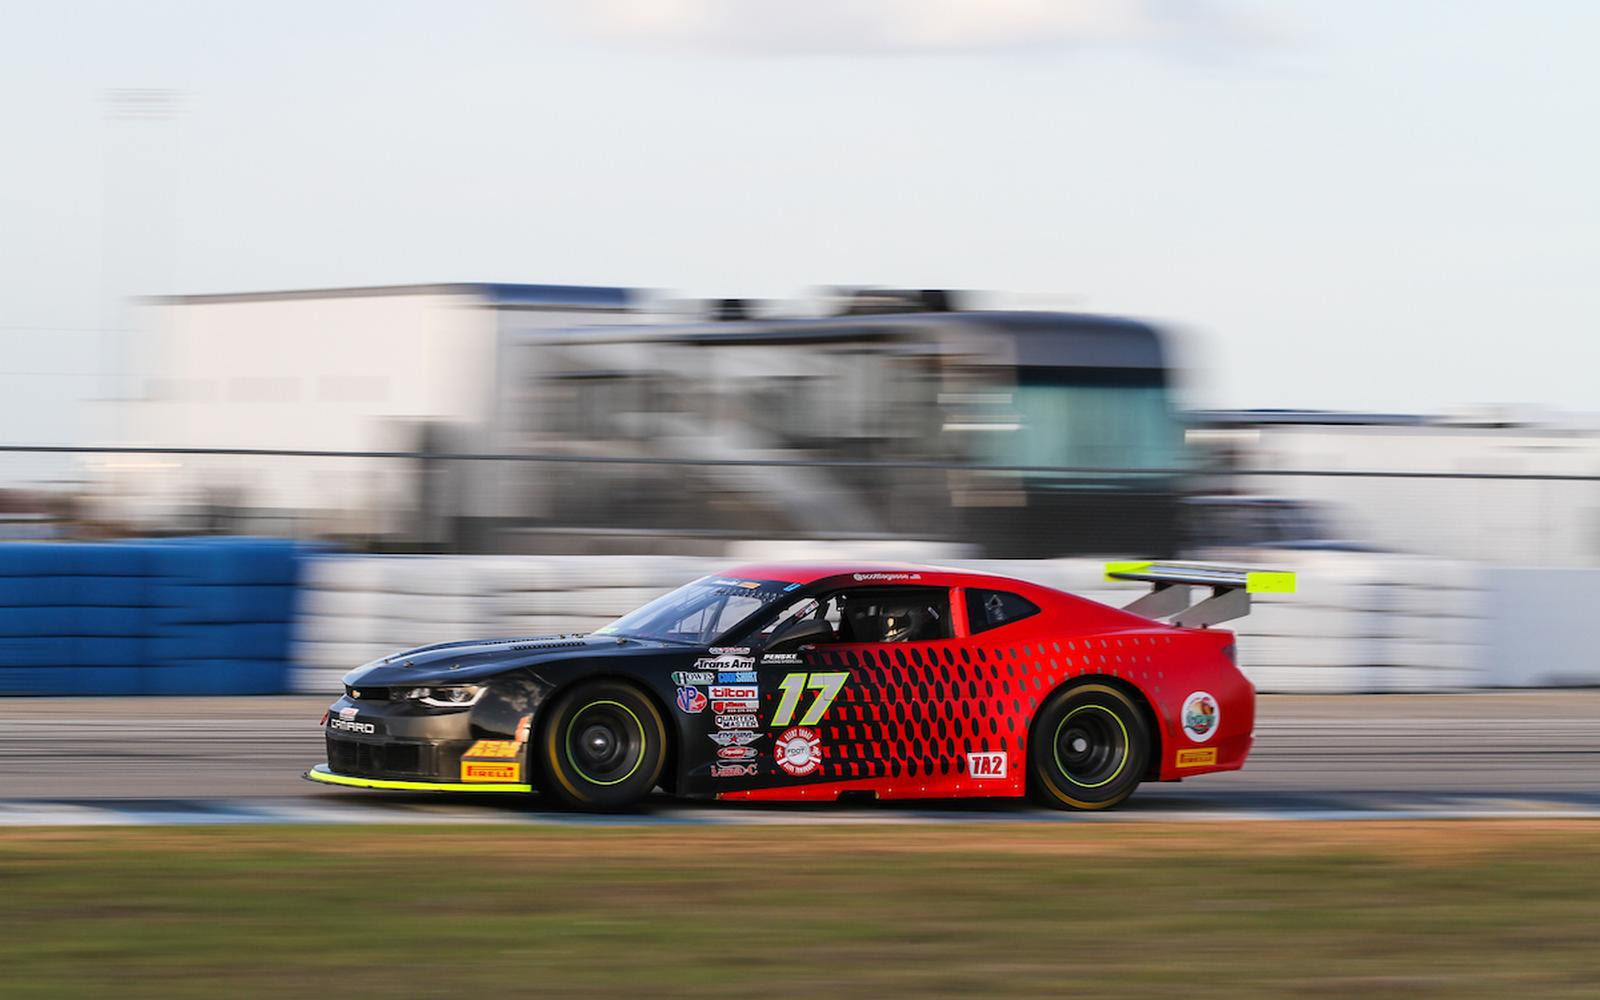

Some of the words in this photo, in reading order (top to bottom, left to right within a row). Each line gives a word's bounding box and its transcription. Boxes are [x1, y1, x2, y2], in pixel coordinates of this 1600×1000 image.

[700, 659, 730, 669] Trans
[731, 658, 752, 669] Am
[678, 687, 698, 712] VP
[712, 688, 755, 698] tilton
[771, 672, 850, 727] 17
[331, 718, 375, 734] CAMARO
[717, 715, 755, 724] QUARTER
[467, 766, 514, 778] PIRELLI
[972, 756, 1003, 774] TA2
